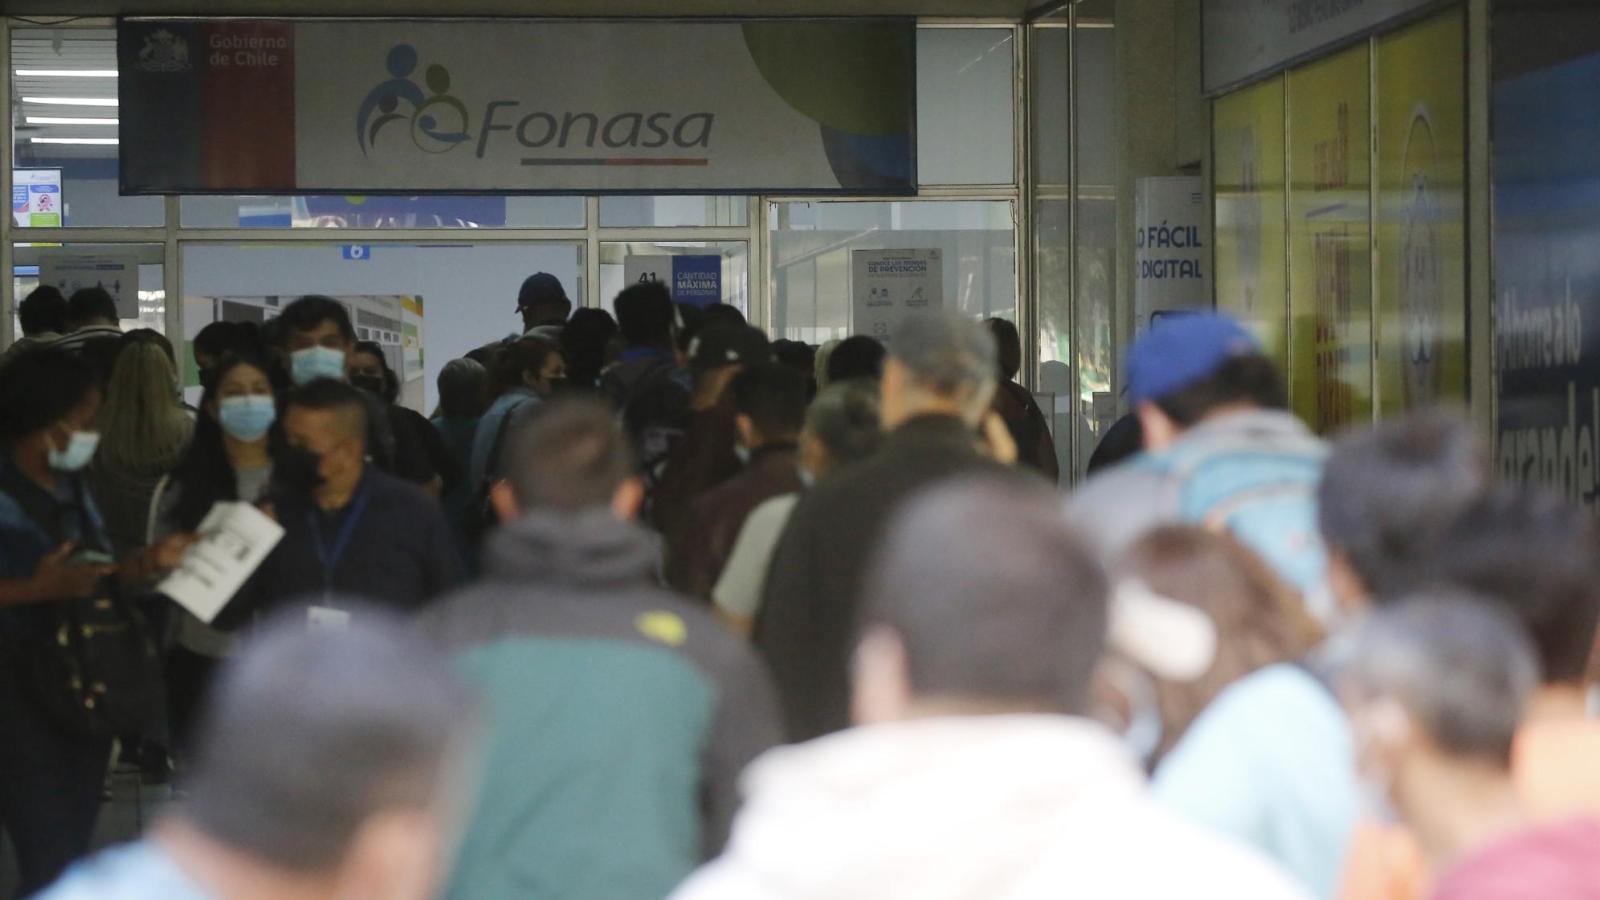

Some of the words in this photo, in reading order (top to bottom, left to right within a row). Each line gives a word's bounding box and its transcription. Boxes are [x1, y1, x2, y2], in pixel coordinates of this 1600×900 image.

[209, 33, 288, 49] Gobierno
[209, 51, 231, 66] de
[235, 51, 279, 66] Chile
[475, 100, 716, 159] Fonasa
[1148, 219, 1202, 249] FÁCIL
[677, 272, 718, 280] CANTIDAD
[1142, 259, 1203, 279] DIGITAL
